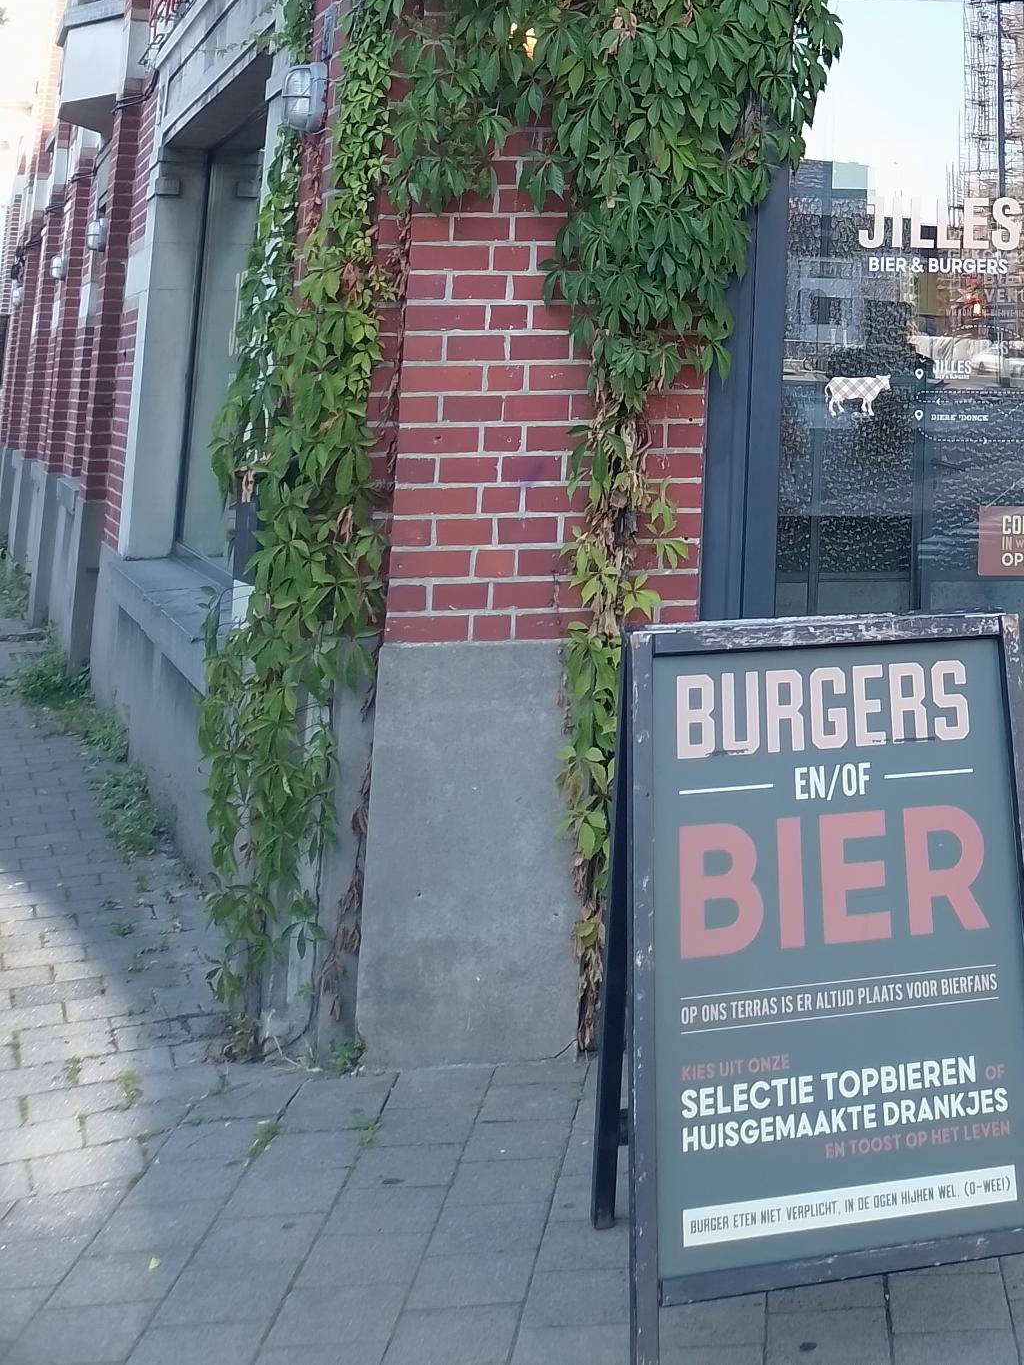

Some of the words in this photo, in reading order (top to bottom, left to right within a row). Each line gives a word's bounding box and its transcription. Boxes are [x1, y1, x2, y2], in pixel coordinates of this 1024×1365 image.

[858, 196, 1023, 251] JILLES
[868, 256, 906, 272] BIER
[911, 257, 925, 272] &
[928, 258, 1008, 274] BURGERS
[933, 359, 972, 374] JILLES
[1002, 536, 1013, 551] IN
[676, 659, 970, 759] BURGERS
[794, 762, 871, 800] EN/OF
[679, 805, 991, 960] BIER
[681, 1006, 698, 1025] OP
[702, 1003, 727, 1022] ONS
[730, 997, 778, 1019] TERRAS
[782, 995, 793, 1013] IS
[797, 994, 812, 1012] ER
[816, 988, 854, 1010] ALTIJD
[858, 983, 903, 1005] PLAATS
[906, 979, 938, 999] VOOR
[941, 973, 998, 996] BIERFANS
[681, 1062, 715, 1081] KIES
[719, 1059, 744, 1077] UIT
[748, 1054, 790, 1073] ONZE
[681, 1075, 814, 1119] SELECTIE
[821, 1055, 976, 1100] TOPBIEREN
[985, 1064, 1005, 1081] OF
[682, 1103, 877, 1153] HUISGEMAAKTE
[883, 1087, 1009, 1127] DRANKJES
[825, 1141, 845, 1159] EN
[850, 1134, 901, 1156] TOOST
[906, 1131, 928, 1148] OP
[931, 1127, 960, 1145] HET
[964, 1120, 1011, 1141] LEVEN
[690, 1215, 729, 1234] BURGER
[733, 1212, 757, 1228] ETEN
[761, 1208, 782, 1225] NIET
[844, 1198, 854, 1213] IN
[858, 1196, 870, 1210] DE
[873, 1192, 898, 1209] OGEN
